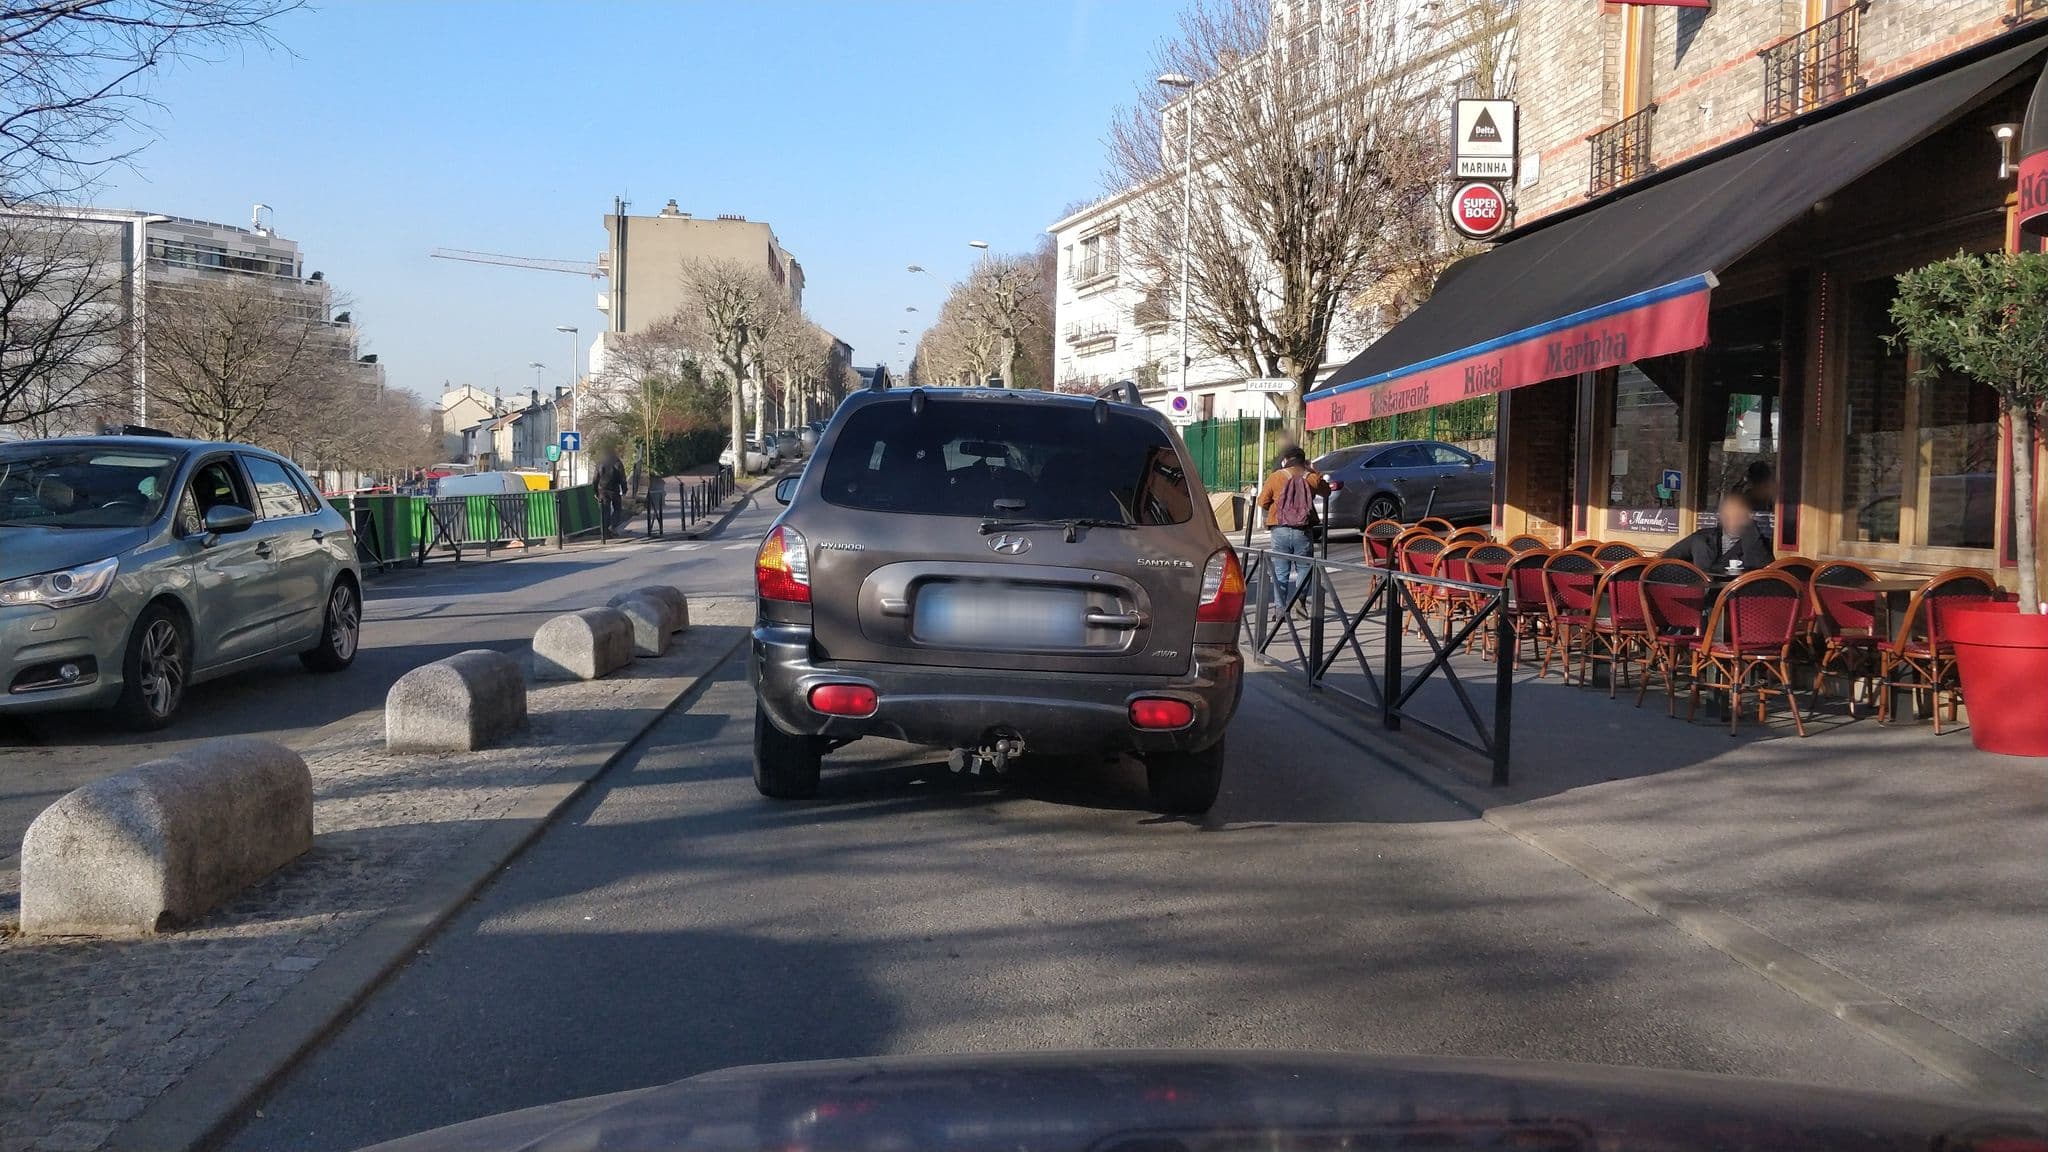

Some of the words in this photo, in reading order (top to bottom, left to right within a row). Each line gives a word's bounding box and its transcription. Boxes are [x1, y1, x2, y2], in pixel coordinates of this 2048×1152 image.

[1475, 126, 1495, 135] Delta
[1462, 162, 1507, 173] MARINHA
[1463, 198, 1497, 209] SUPER
[1466, 208, 1496, 218] BOCK
[1331, 401, 1346, 424] Bar
[1464, 359, 1503, 395] Hôtel
[1545, 328, 1626, 374] Marinha
[1629, 508, 1667, 527] Marinha
